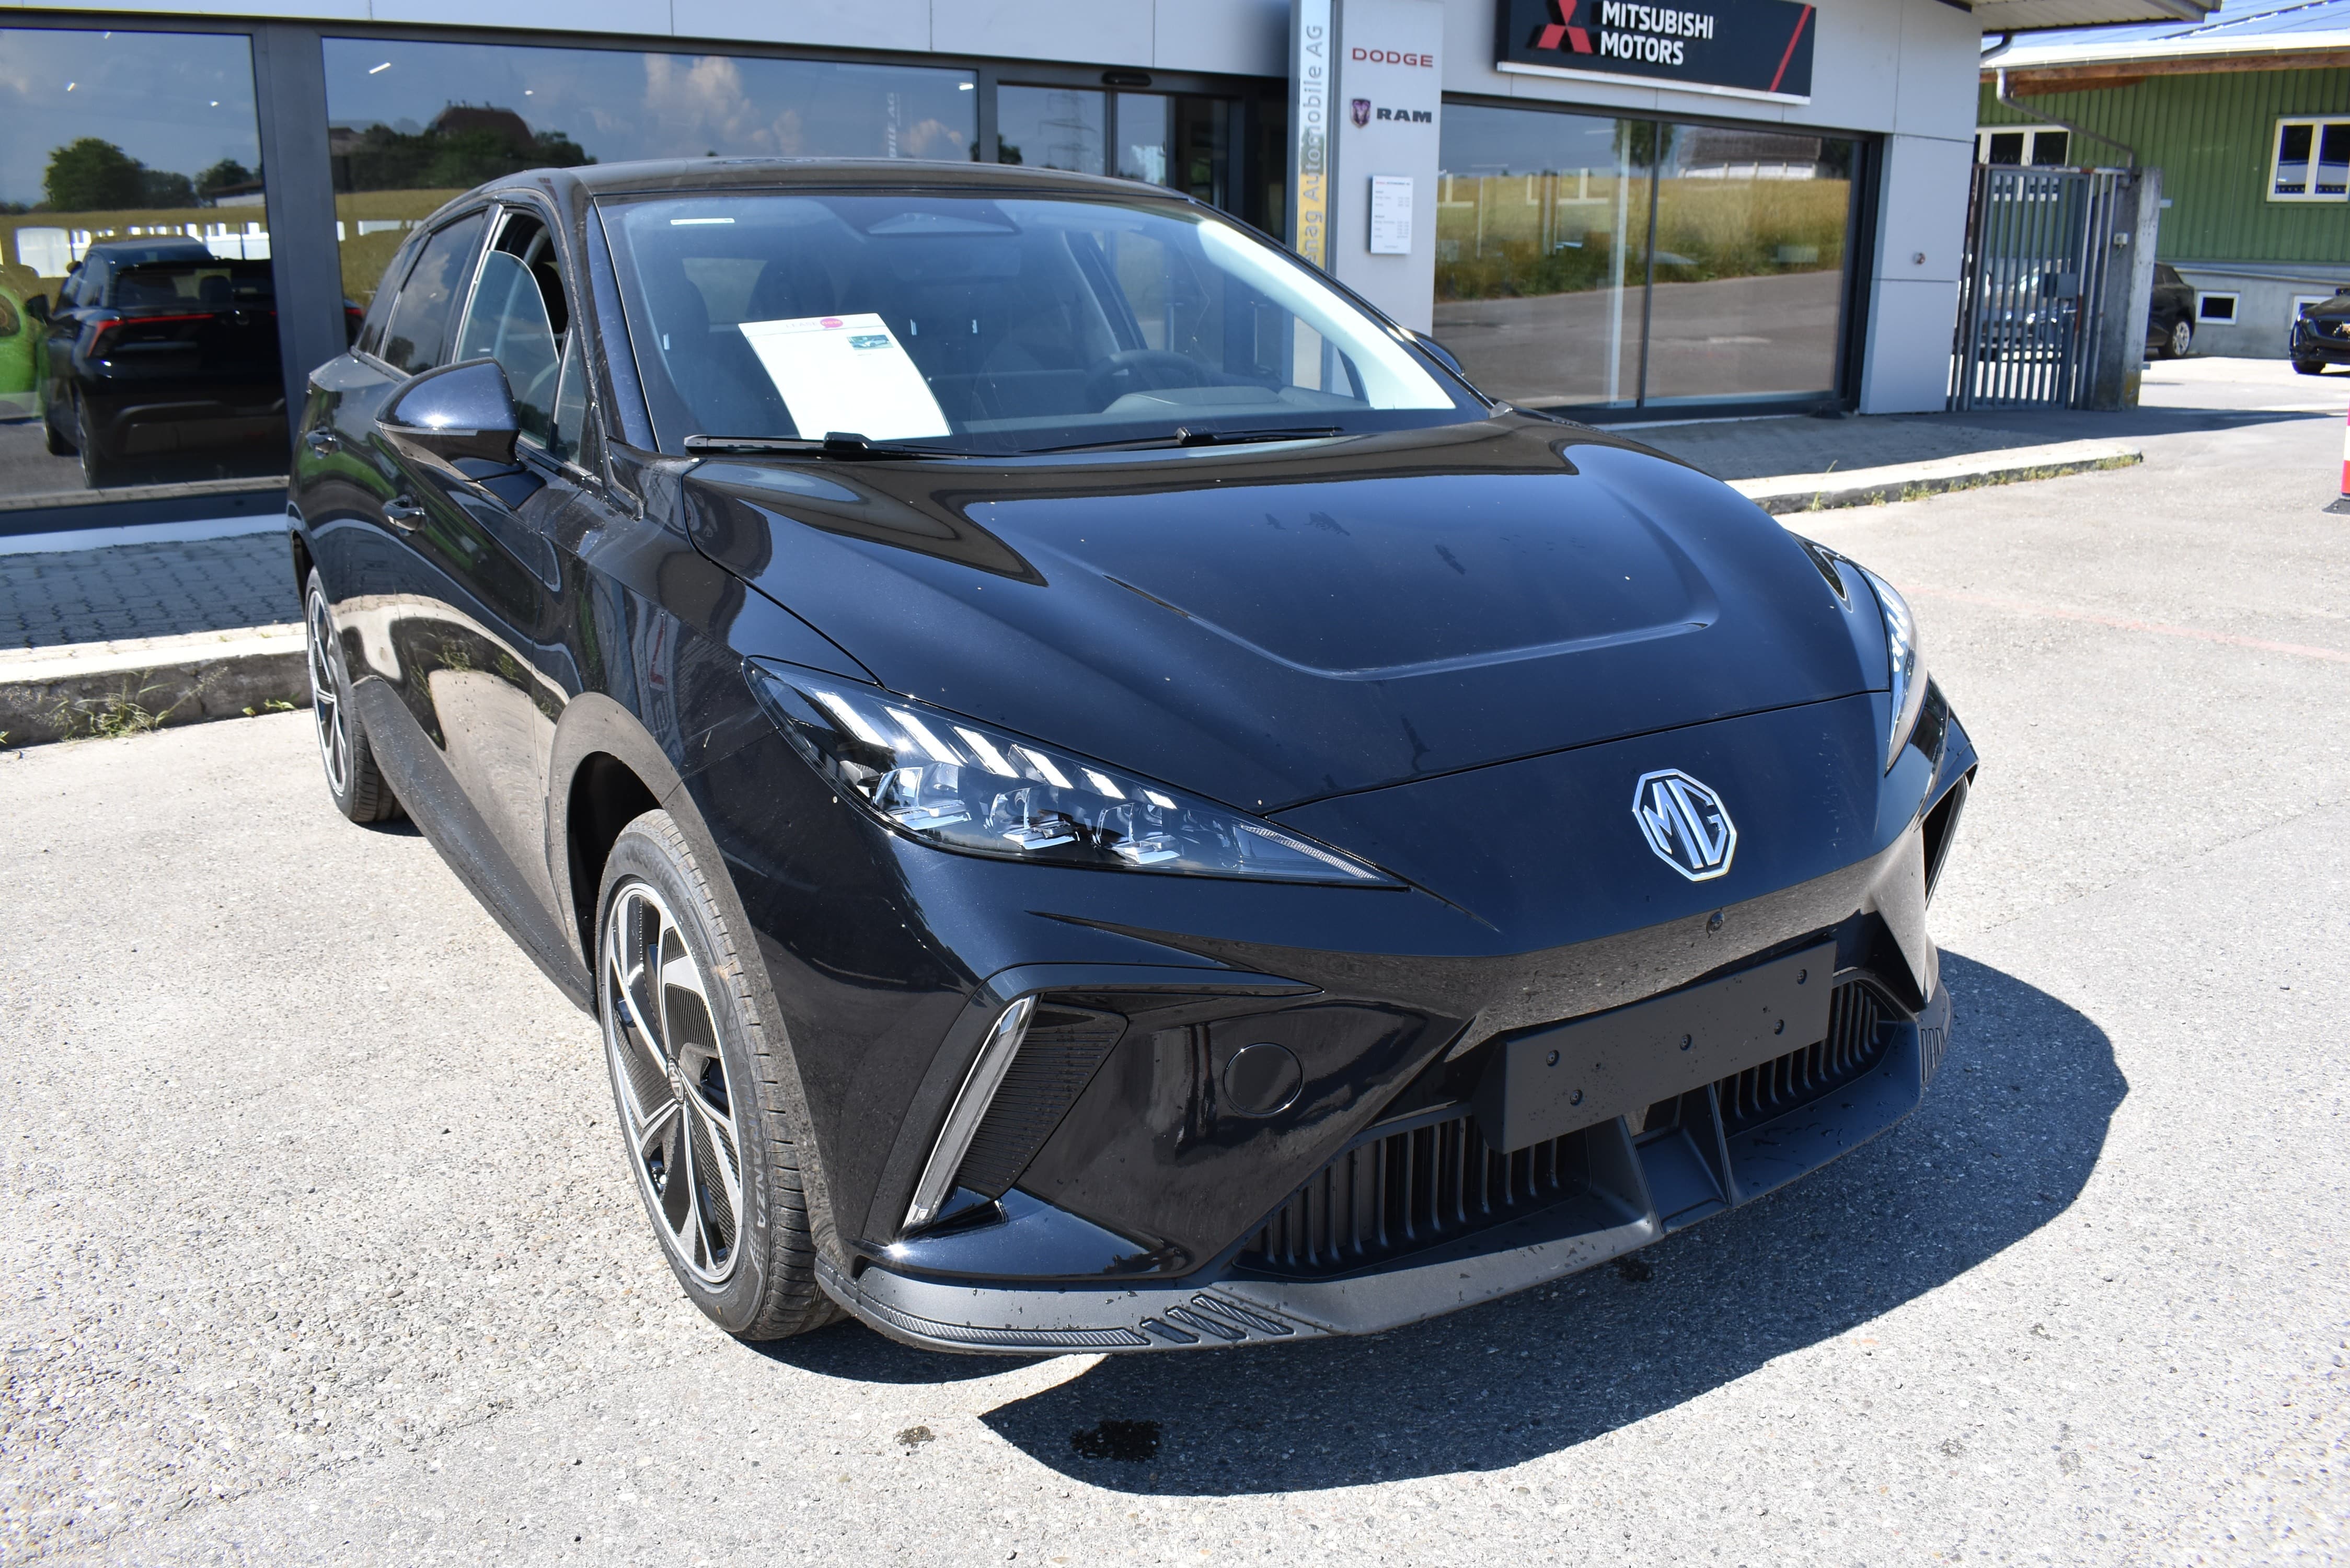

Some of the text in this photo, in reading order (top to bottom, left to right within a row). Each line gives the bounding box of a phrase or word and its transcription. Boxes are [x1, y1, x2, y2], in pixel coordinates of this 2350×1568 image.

[1602, 0, 1714, 40] MITSUBISHI
[1306, 26, 1323, 57] AG
[1352, 48, 1433, 67] DODGE
[1600, 31, 1684, 65] MOTORS
[1376, 108, 1432, 123] RAM
[1303, 65, 1322, 202] Automobile
[1643, 778, 1727, 869] MG
